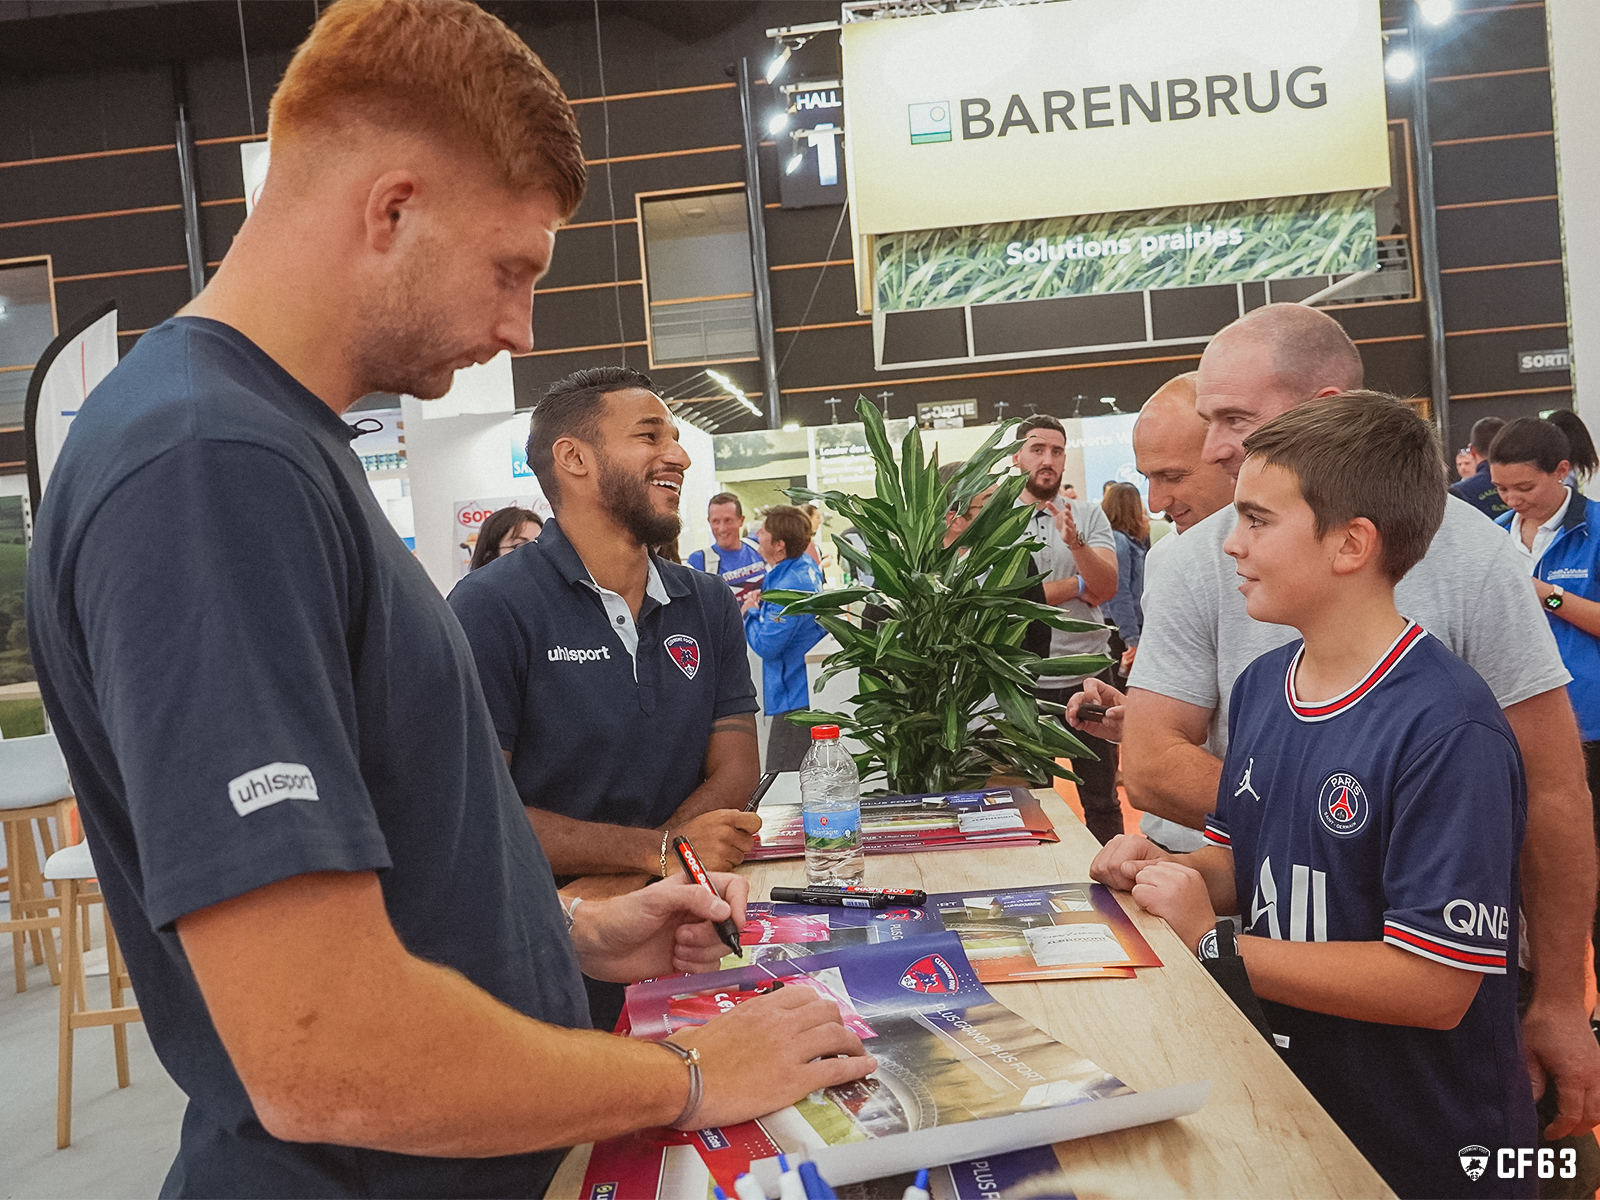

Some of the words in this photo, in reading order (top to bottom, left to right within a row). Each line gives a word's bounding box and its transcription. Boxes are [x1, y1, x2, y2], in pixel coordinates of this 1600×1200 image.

[796, 91, 842, 110] HALL
[960, 65, 1328, 141] BARENBRUG
[808, 123, 838, 186] 1
[1006, 237, 1131, 266] Solutions
[1140, 222, 1244, 259] prairies
[1521, 354, 1568, 369] SORTI
[920, 403, 976, 420] SORTIE
[1065, 434, 1113, 449] ouverts
[547, 645, 611, 664] uhlsport
[1330, 776, 1361, 796] PARIS
[934, 1003, 960, 1023] PLUS
[953, 1020, 991, 1046] GRAND,
[989, 1044, 1018, 1064] PLUS
[1009, 1062, 1046, 1083] FORT
[970, 1160, 998, 1190] PLUS
